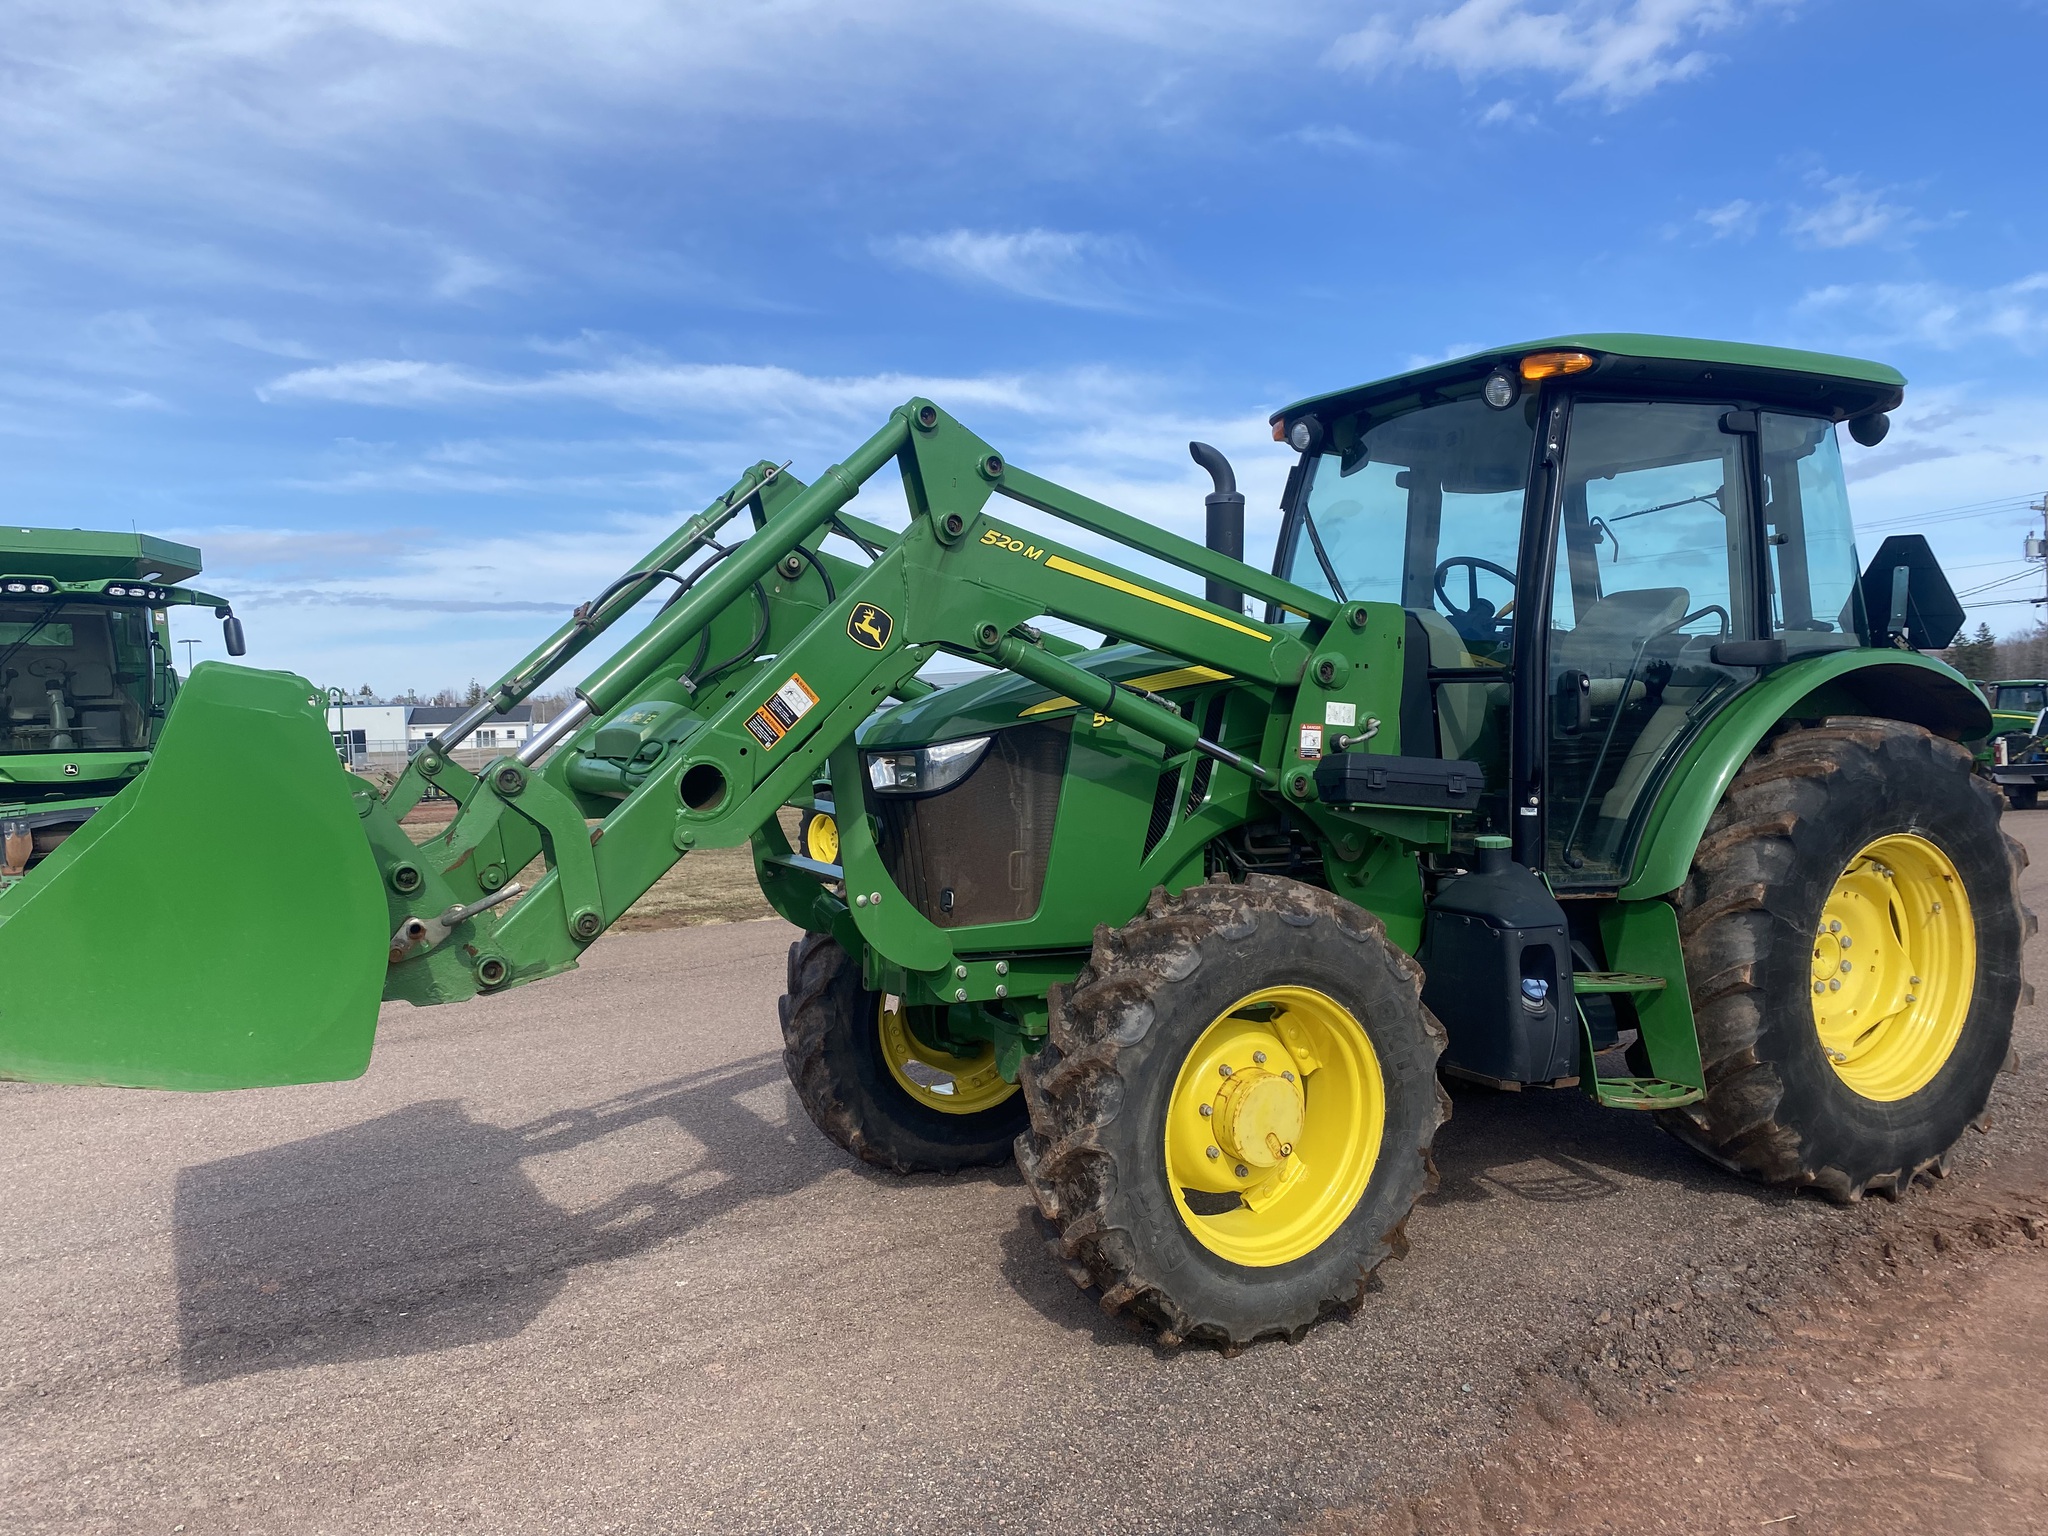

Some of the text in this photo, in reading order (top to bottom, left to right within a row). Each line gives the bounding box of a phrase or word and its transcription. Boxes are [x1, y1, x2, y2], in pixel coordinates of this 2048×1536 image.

[979, 529, 1025, 552] 520
[797, 680, 816, 700] WARNING
[763, 714, 782, 734] WARNING
